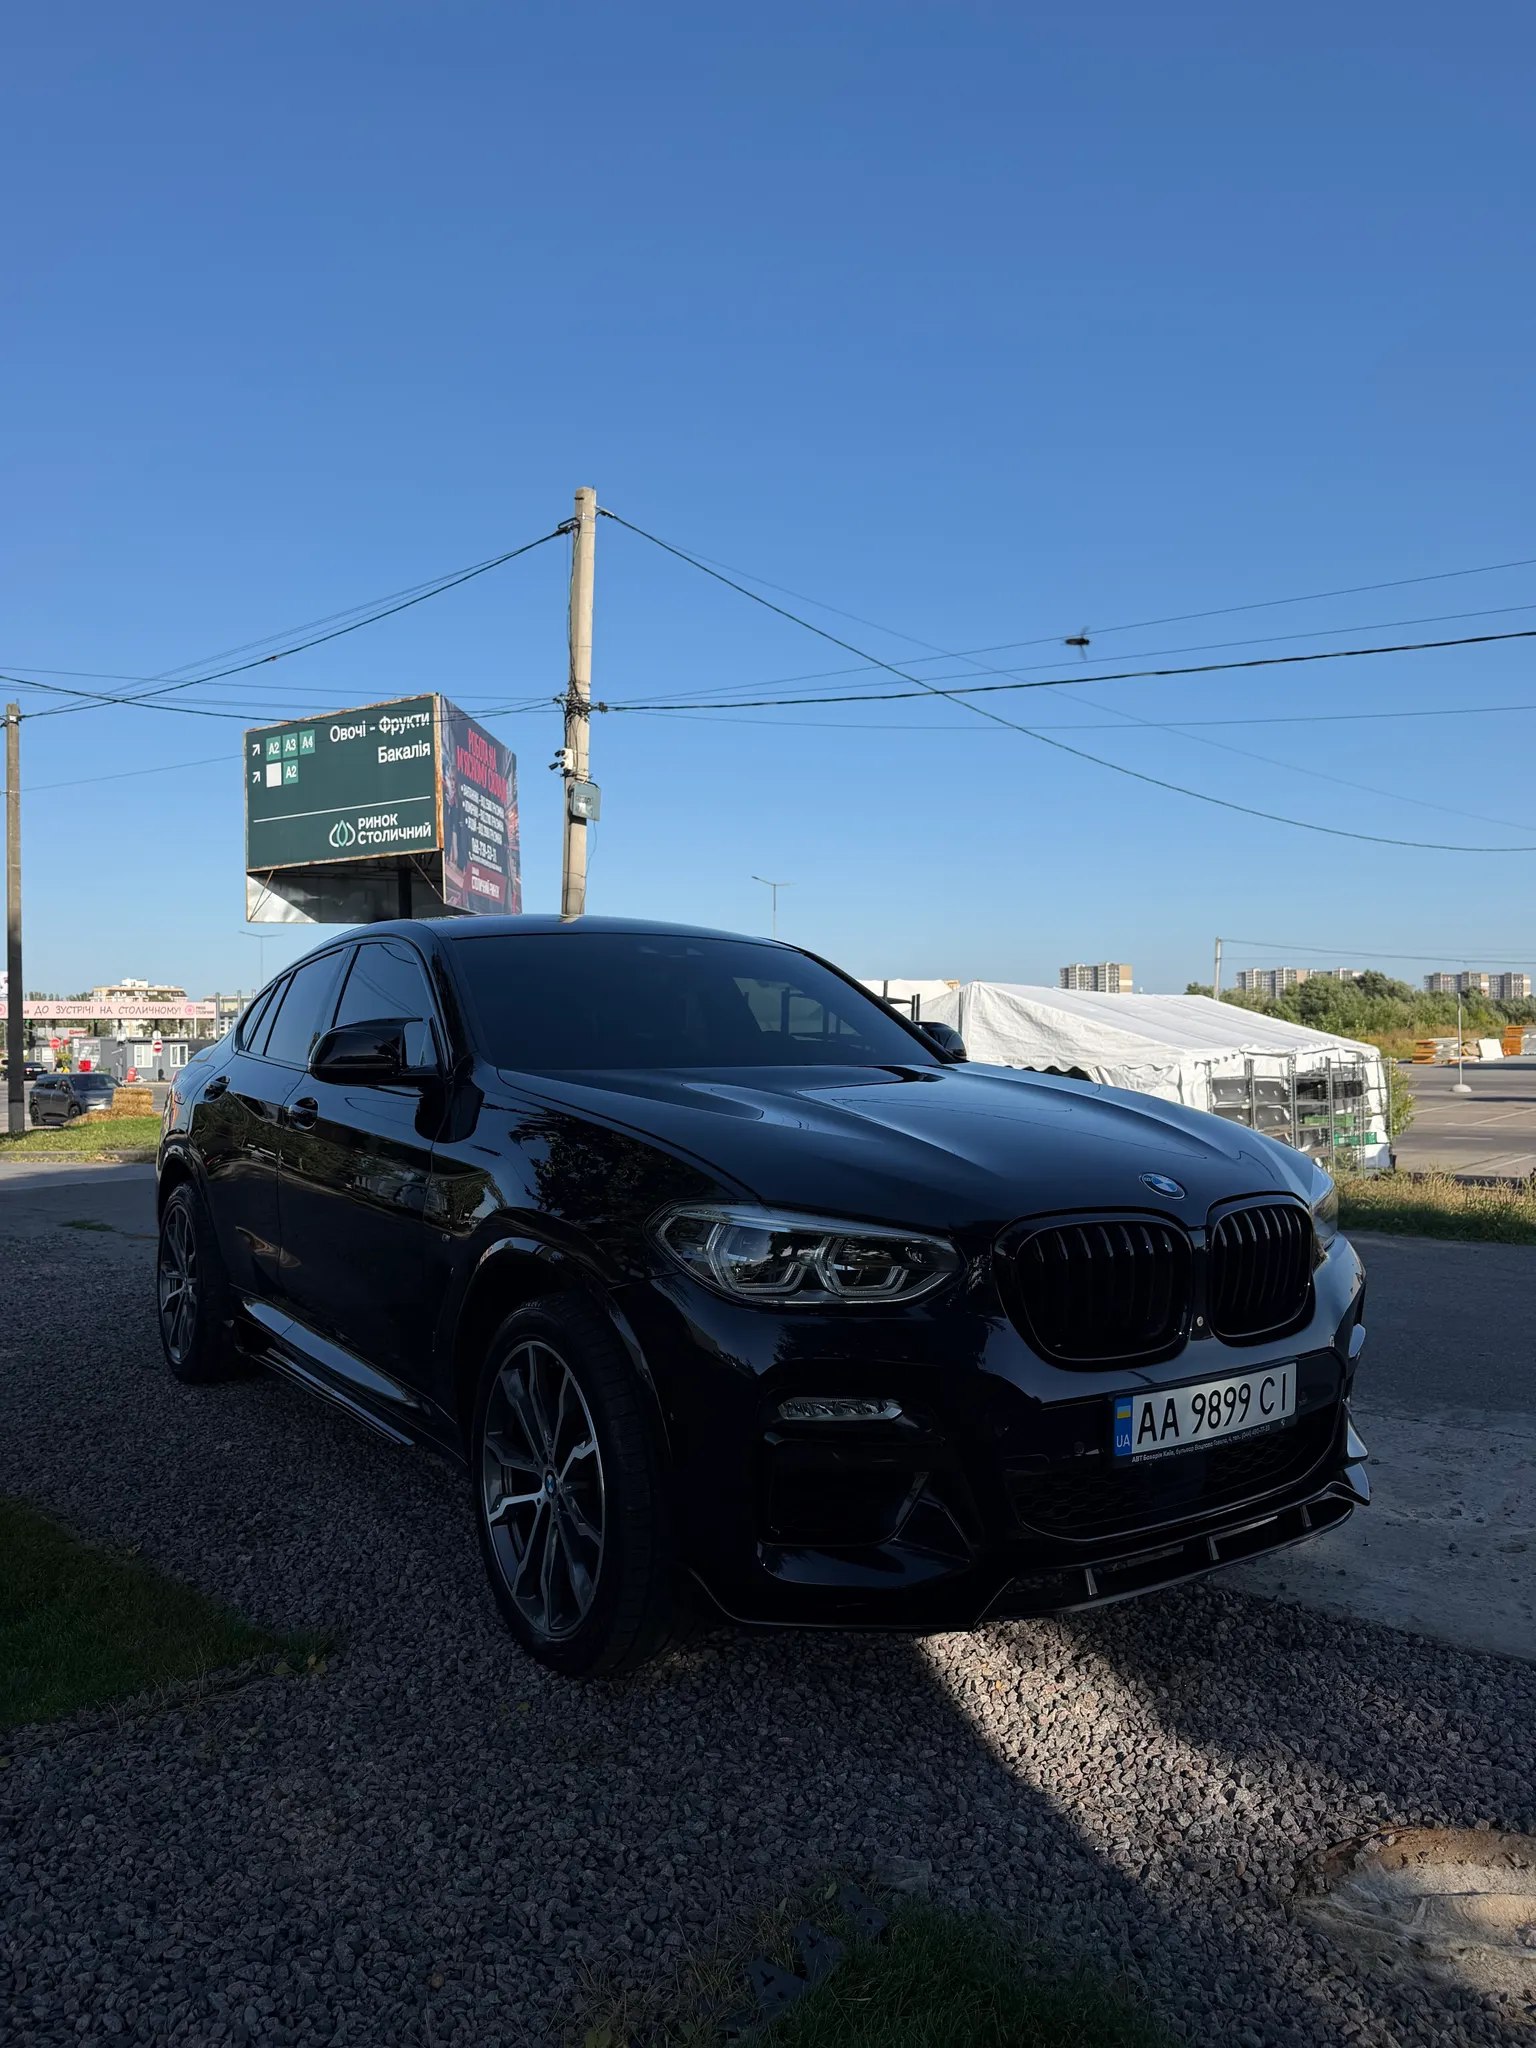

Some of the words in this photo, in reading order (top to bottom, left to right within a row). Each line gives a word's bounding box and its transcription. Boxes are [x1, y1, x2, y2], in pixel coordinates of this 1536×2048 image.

[330, 720, 366, 742] Овочі
[379, 712, 430, 736] Фрукти
[378, 739, 431, 763] Бакалія
[358, 813, 399, 830] РИНОК
[357, 822, 431, 845] СТОЛИЧНИЙ
[34, 1005, 49, 1016] ДО
[55, 1005, 94, 1014] ЗУСТРІЧІ
[100, 1005, 113, 1014] НА
[118, 1006, 182, 1015] СТОЛИЧНОМУ!
[1137, 1397, 1179, 1445] AA
[1191, 1382, 1251, 1434] 9899
[1260, 1372, 1287, 1416] CI
[1116, 1434, 1131, 1448] UA
